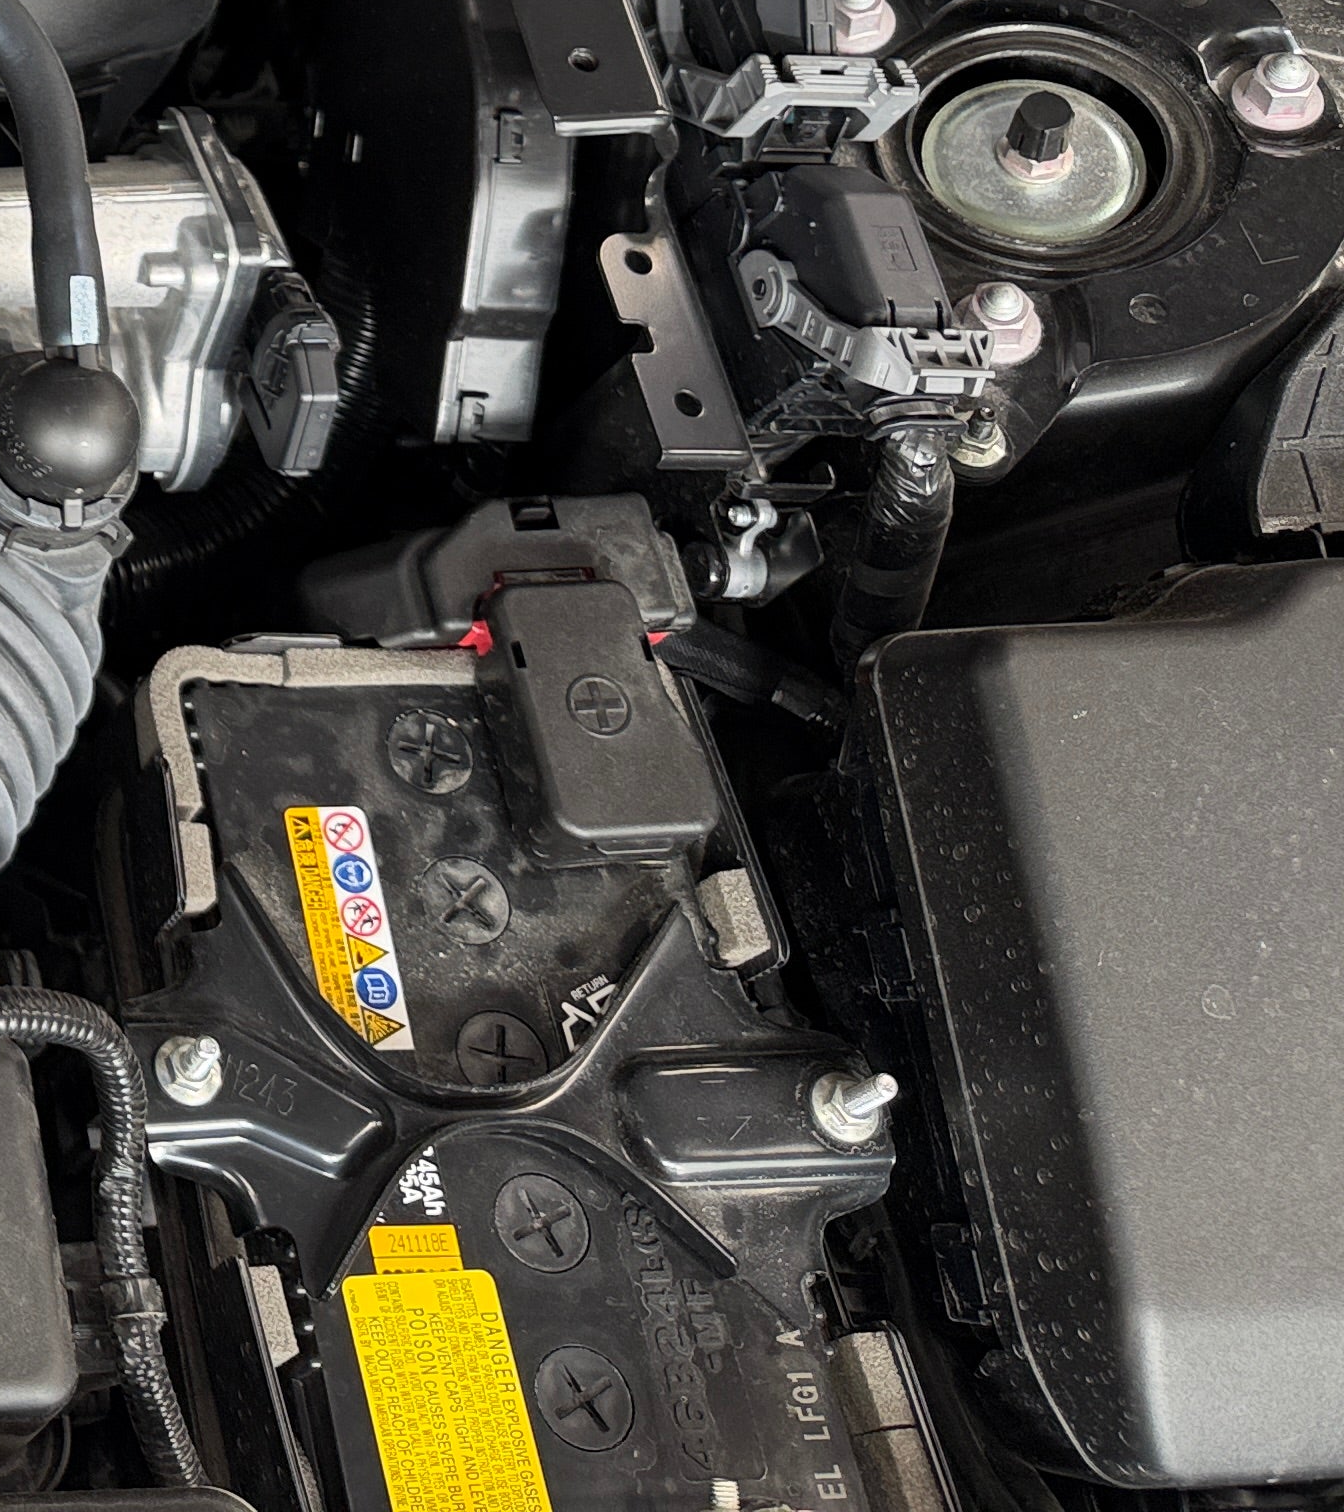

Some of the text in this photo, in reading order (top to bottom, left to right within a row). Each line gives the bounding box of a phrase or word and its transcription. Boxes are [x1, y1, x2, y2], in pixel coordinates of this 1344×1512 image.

[568, 971, 611, 1001] RETURN
[415, 1156, 446, 1217] 45Ah
[388, 1232, 449, 1252] 241118E
[372, 1282, 388, 1301] EVENT
[366, 1316, 386, 1346] KEEP
[426, 1312, 446, 1343] KEEP
[456, 1321, 470, 1334] AND
[404, 1307, 438, 1374] POISON
[374, 1348, 393, 1373] OUT
[388, 1348, 404, 1369] FLUSH
[435, 1346, 455, 1377] VENT
[464, 1353, 480, 1372] FROM
[476, 1350, 489, 1359] OR
[380, 1376, 397, 1392] OF
[394, 1371, 409, 1388] WITH
[408, 1371, 424, 1391] AVOID
[433, 1279, 445, 1288] OR
[459, 1384, 477, 1414] WITHOUT
[474, 1446, 496, 1490] INSTRUCTION
[422, 1380, 447, 1430] CAUSES
[443, 1380, 463, 1412] CAPS
[487, 1392, 503, 1415] COULD
[785, 1368, 831, 1443] LFG1
[373, 1403, 393, 1437] AMERICAN
[385, 1396, 408, 1436] REACH
[412, 1394, 431, 1424] CONTACT
[479, 1312, 542, 1511] DANGER EXPLOSIVE GASES
[405, 1418, 420, 1431] AND
[451, 1415, 473, 1451] TIGHT
[493, 1416, 508, 1438] CAUSE
[396, 1439, 413, 1456] OF
[408, 1433, 423, 1448] CALL
[421, 1429, 437, 1446] WITH
[434, 1432, 460, 1482] SEVERE
[461, 1454, 480, 1480] AND
[499, 1440, 516, 1470] BATTERY
[414, 1458, 434, 1494] PHYSICIAN
[431, 1472, 447, 1489] EYES
[491, 1464, 505, 1474] OR
[507, 1473, 519, 1482] TO
[494, 1476, 508, 1488] USE
[436, 1493, 450, 1503] OR
